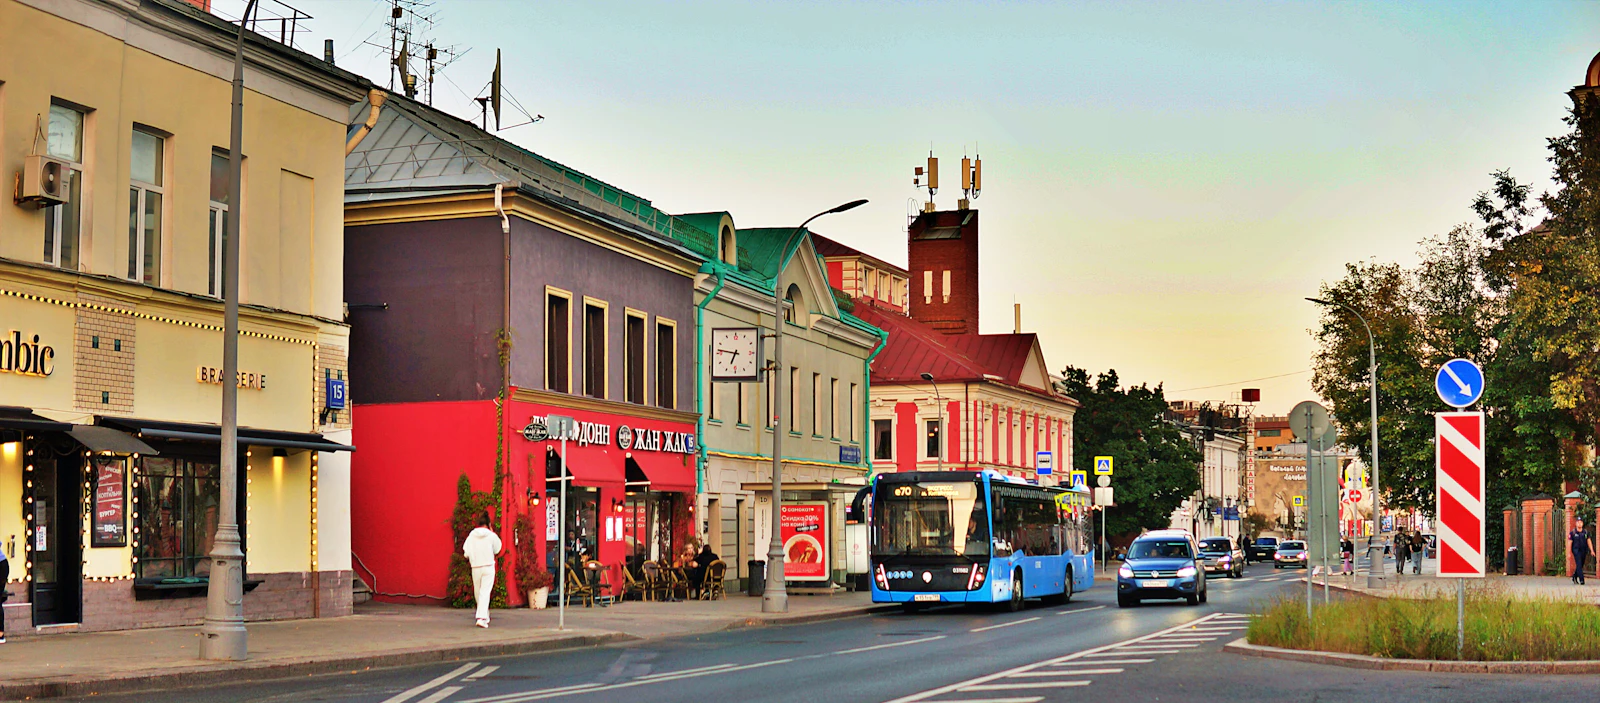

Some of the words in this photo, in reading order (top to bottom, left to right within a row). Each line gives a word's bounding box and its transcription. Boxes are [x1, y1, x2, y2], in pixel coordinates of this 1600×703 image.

[200, 366, 266, 389] BRASERIE
[332, 384, 343, 399] 15
[579, 422, 610, 447] ДОНН
[634, 428, 661, 451] ЖАН
[664, 431, 687, 453] ЖАК
[687, 436, 694, 447] 15
[104, 524, 117, 533] BBQ
